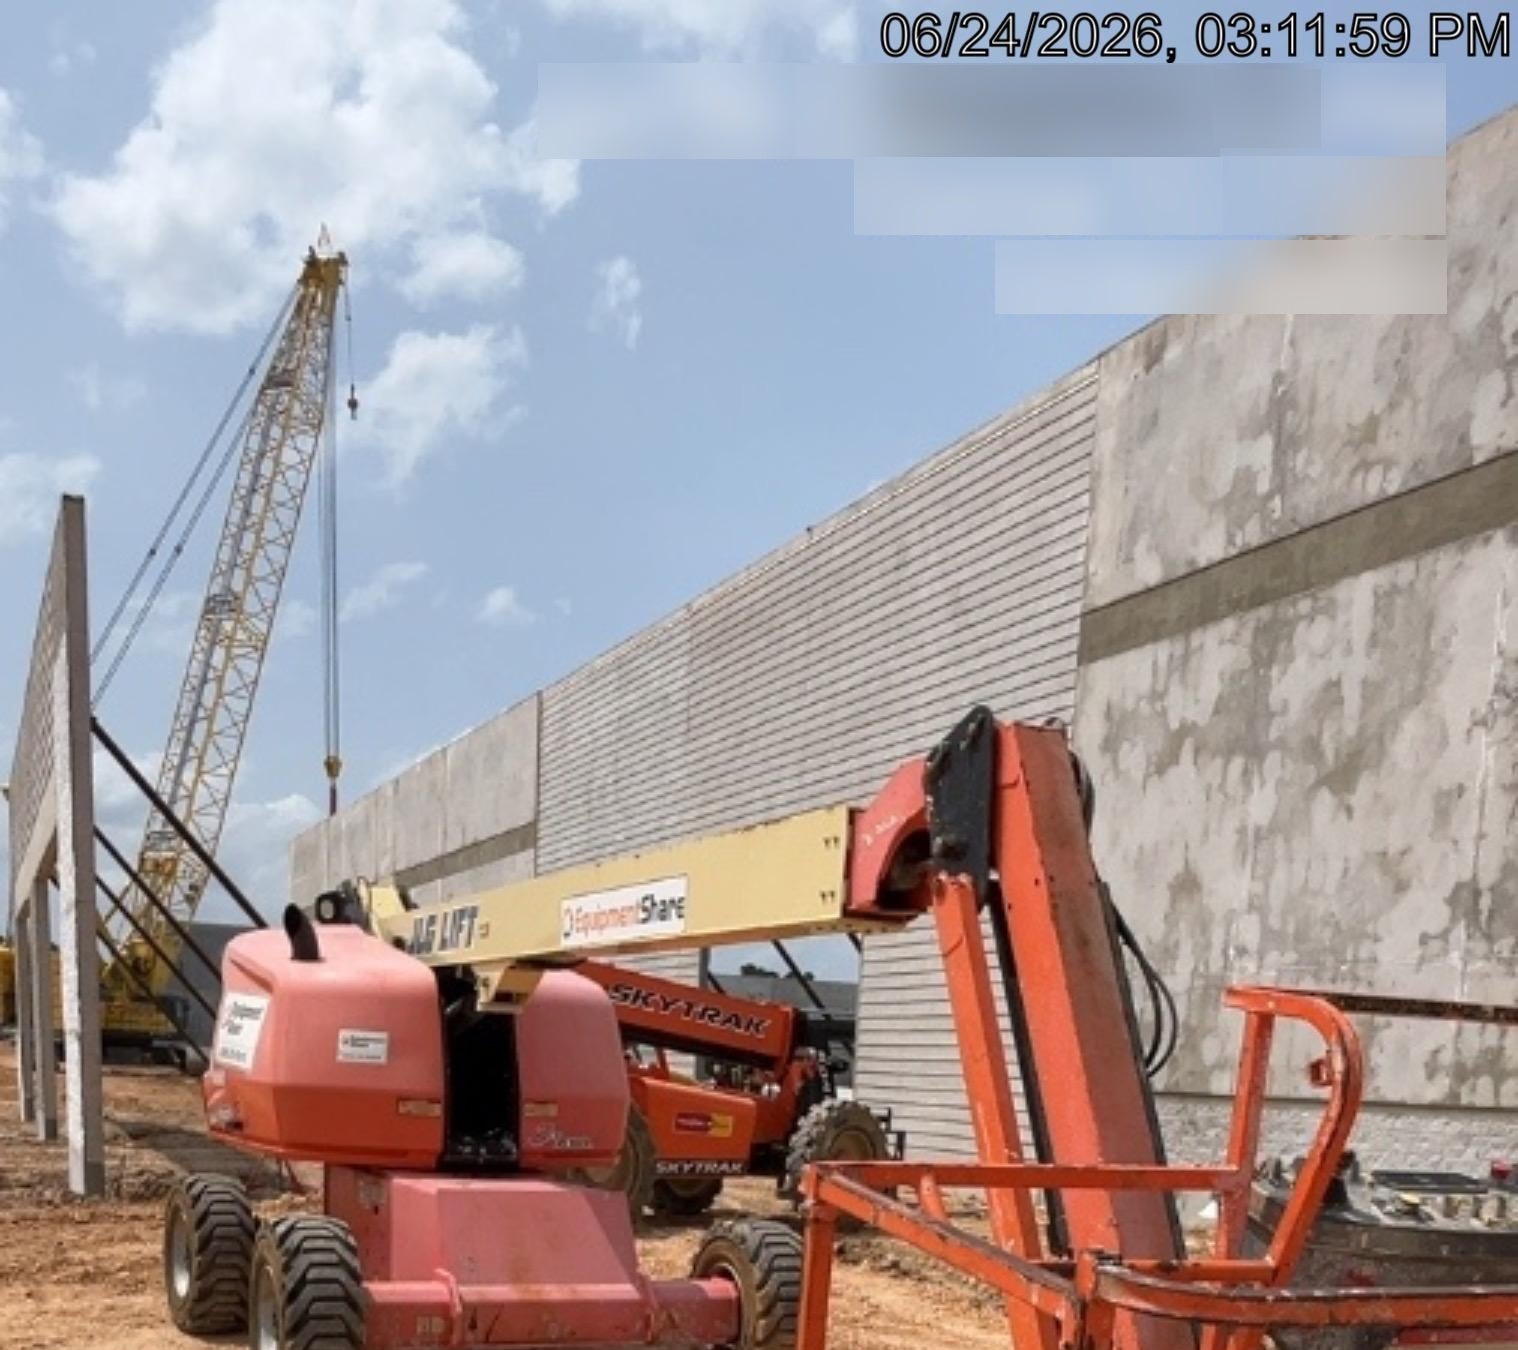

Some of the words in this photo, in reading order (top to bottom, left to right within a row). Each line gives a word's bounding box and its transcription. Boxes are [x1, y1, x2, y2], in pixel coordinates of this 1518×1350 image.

[438, 905, 479, 951] LIFT
[575, 893, 686, 937] EquipmentShare
[608, 983, 772, 1038] SKYTRAK
[655, 1162, 743, 1175] SKYTRAK
